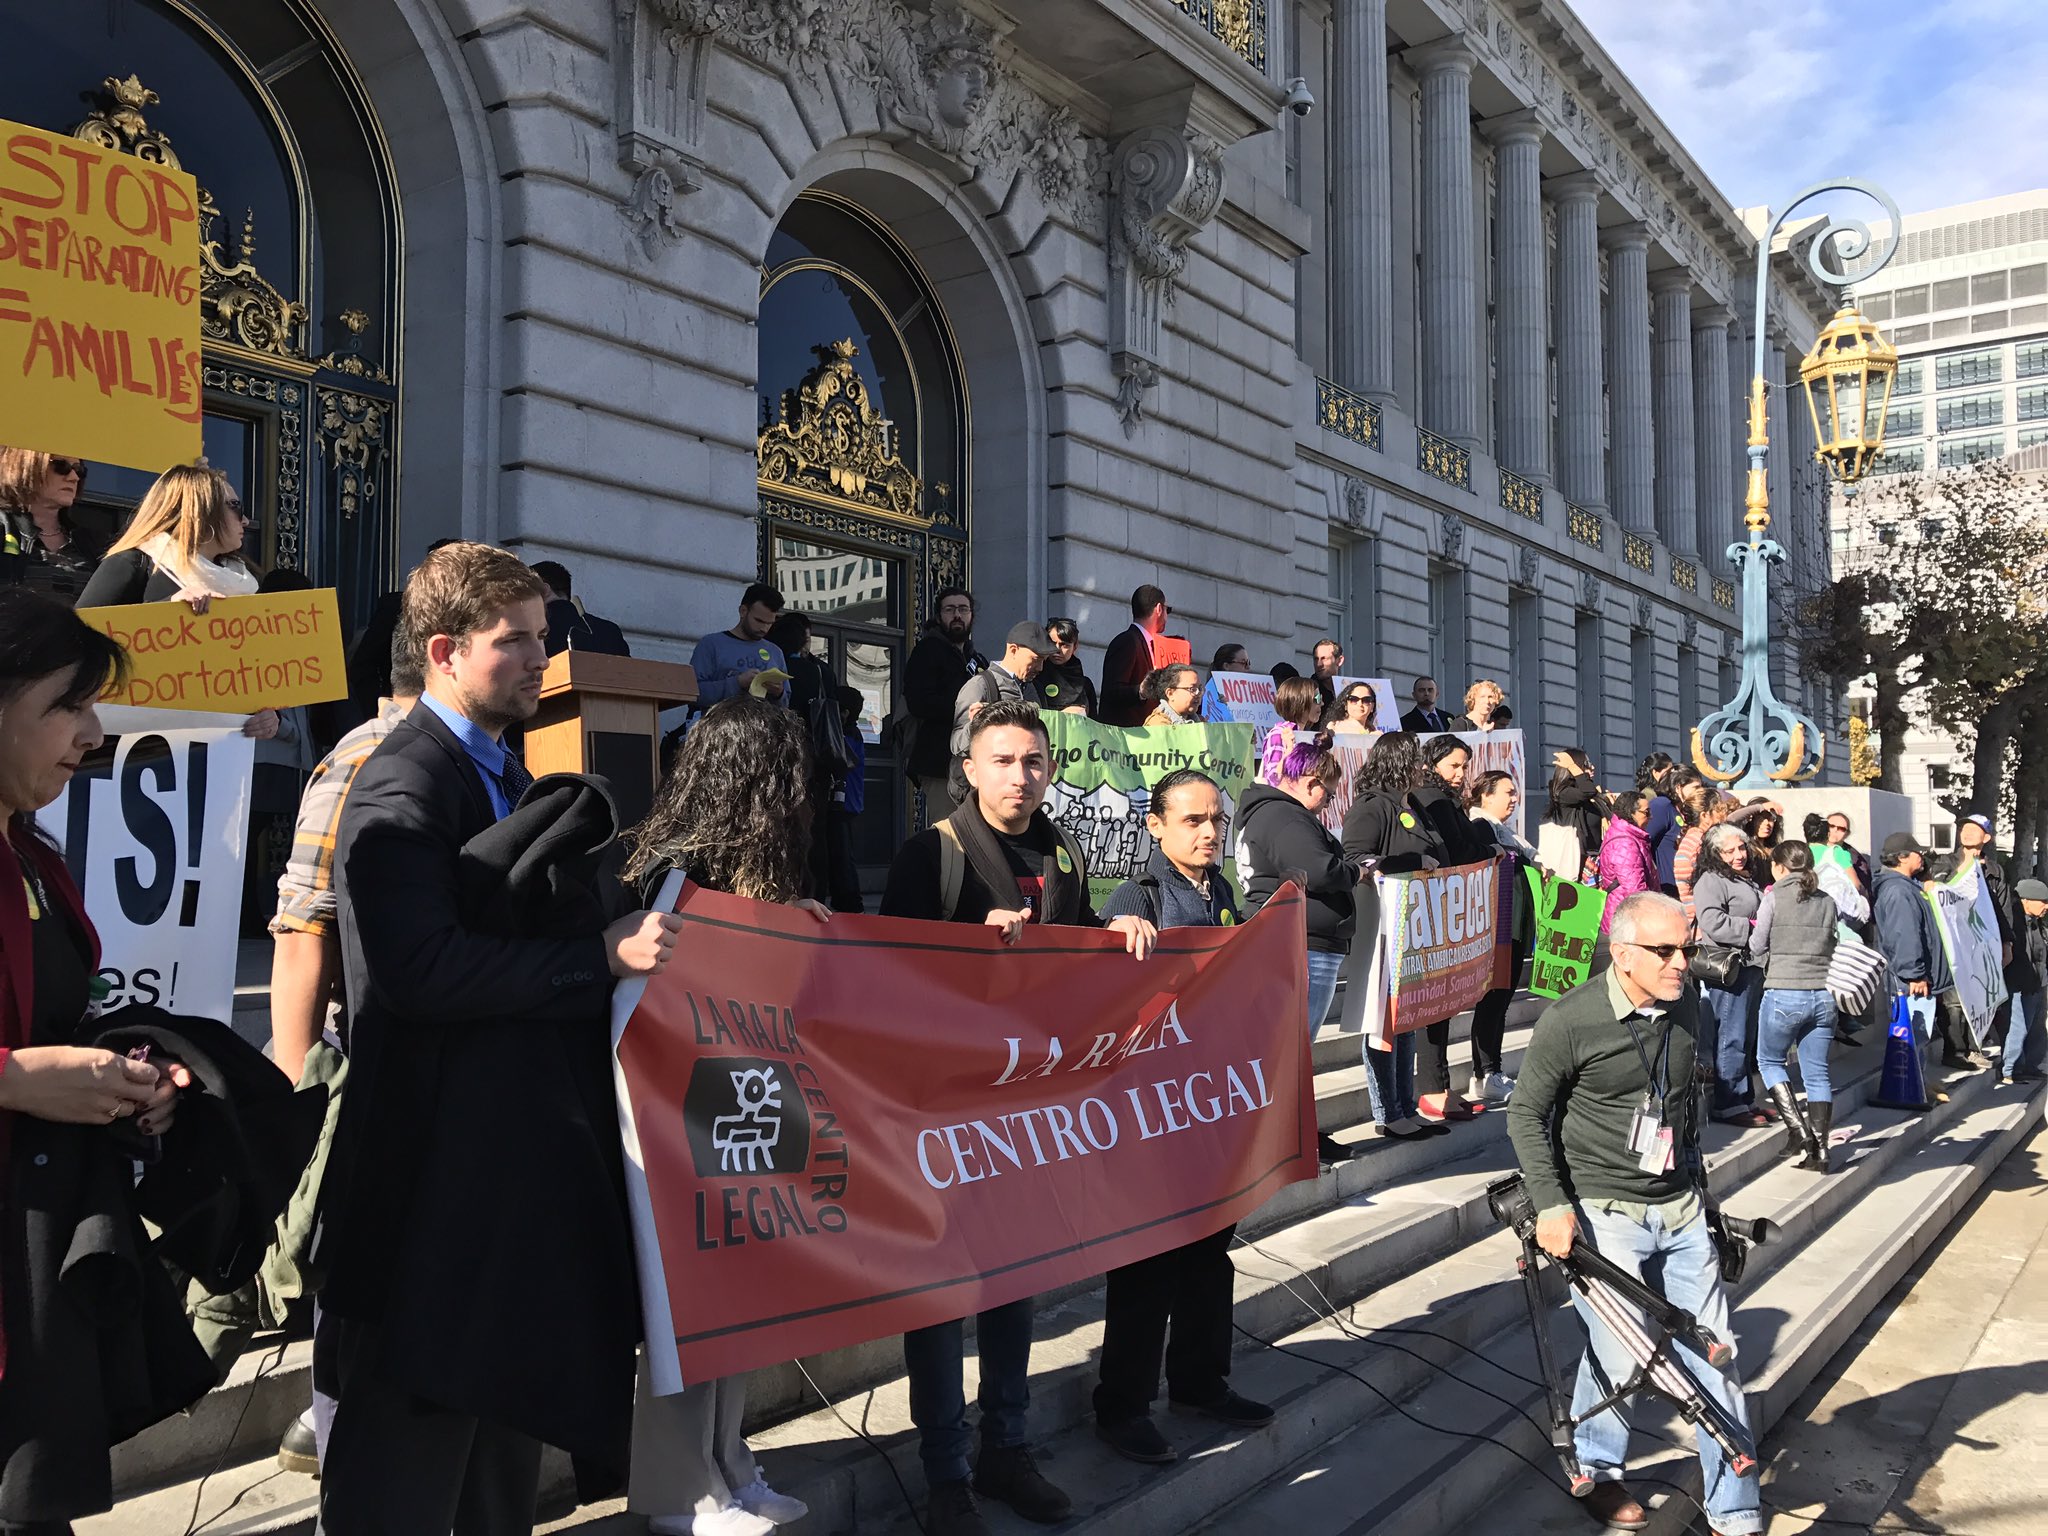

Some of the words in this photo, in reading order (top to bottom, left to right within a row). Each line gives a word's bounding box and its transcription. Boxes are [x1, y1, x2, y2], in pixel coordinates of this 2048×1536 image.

[0, 134, 196, 246] STOP
[105, 615, 202, 653] back
[208, 602, 323, 650] against
[1222, 678, 1275, 704] NOTHING
[1087, 739, 1194, 771] Community
[1198, 749, 1247, 780] Center
[1449, 972, 1475, 994] Somos
[684, 990, 736, 1046] LA
[727, 999, 806, 1056] RAZA
[989, 1036, 1064, 1087] LA
[1067, 998, 1193, 1072] RAZA
[794, 1061, 850, 1234] CENTRO
[916, 1096, 1119, 1189] CENTRO
[1124, 1058, 1275, 1141] LEGAL
[695, 1184, 820, 1251] LEGAL
